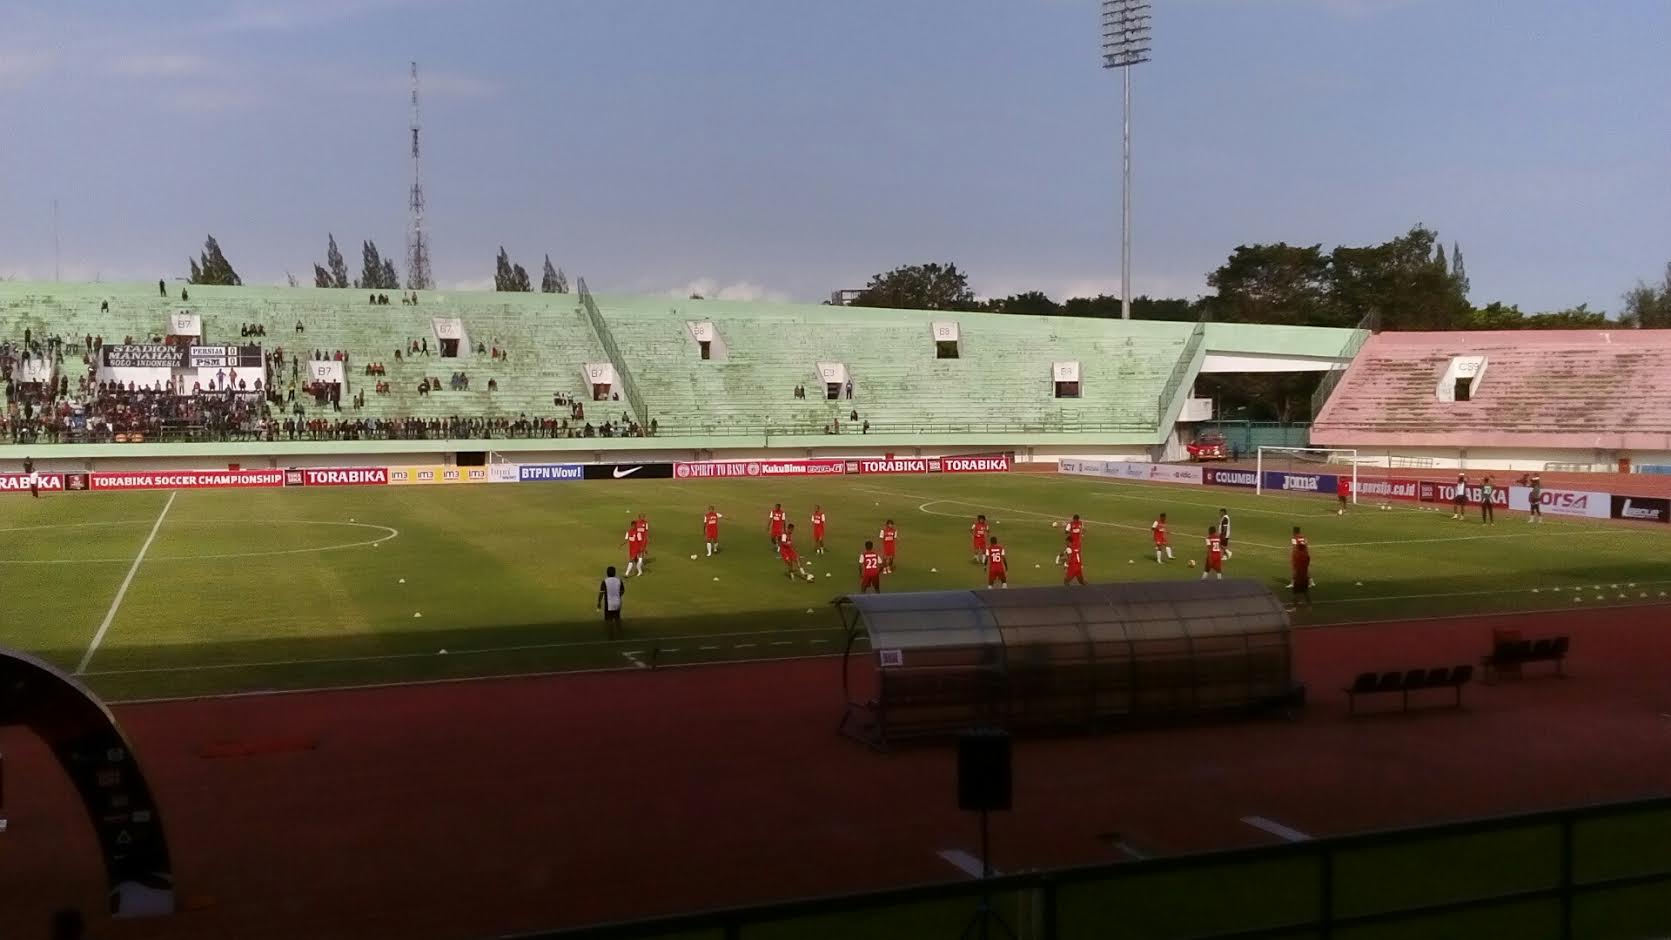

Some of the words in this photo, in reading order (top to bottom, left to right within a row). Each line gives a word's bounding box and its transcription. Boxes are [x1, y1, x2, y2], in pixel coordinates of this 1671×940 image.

[108, 352, 183, 360] MANAHAN
[230, 347, 236, 355] 0
[137, 359, 181, 367] INDONESIA
[196, 358, 220, 366] PSM
[230, 357, 236, 365] 0
[318, 367, 332, 376] B7
[690, 464, 715, 477] SPIRIT
[762, 464, 806, 473] KukuBima
[863, 460, 925, 472] TORABIKA
[946, 459, 1007, 471] TORABIKA
[308, 470, 386, 483] TORABIKA
[522, 467, 550, 478] BTPN
[552, 466, 581, 477] Wow!
[0, 477, 61, 489] RABKA
[93, 476, 152, 487] TORABIKA
[154, 475, 197, 485] SOCCER
[199, 474, 282, 484] CHAMPIONSHIP
[991, 552, 1001, 562] 16
[865, 558, 877, 569] 22
